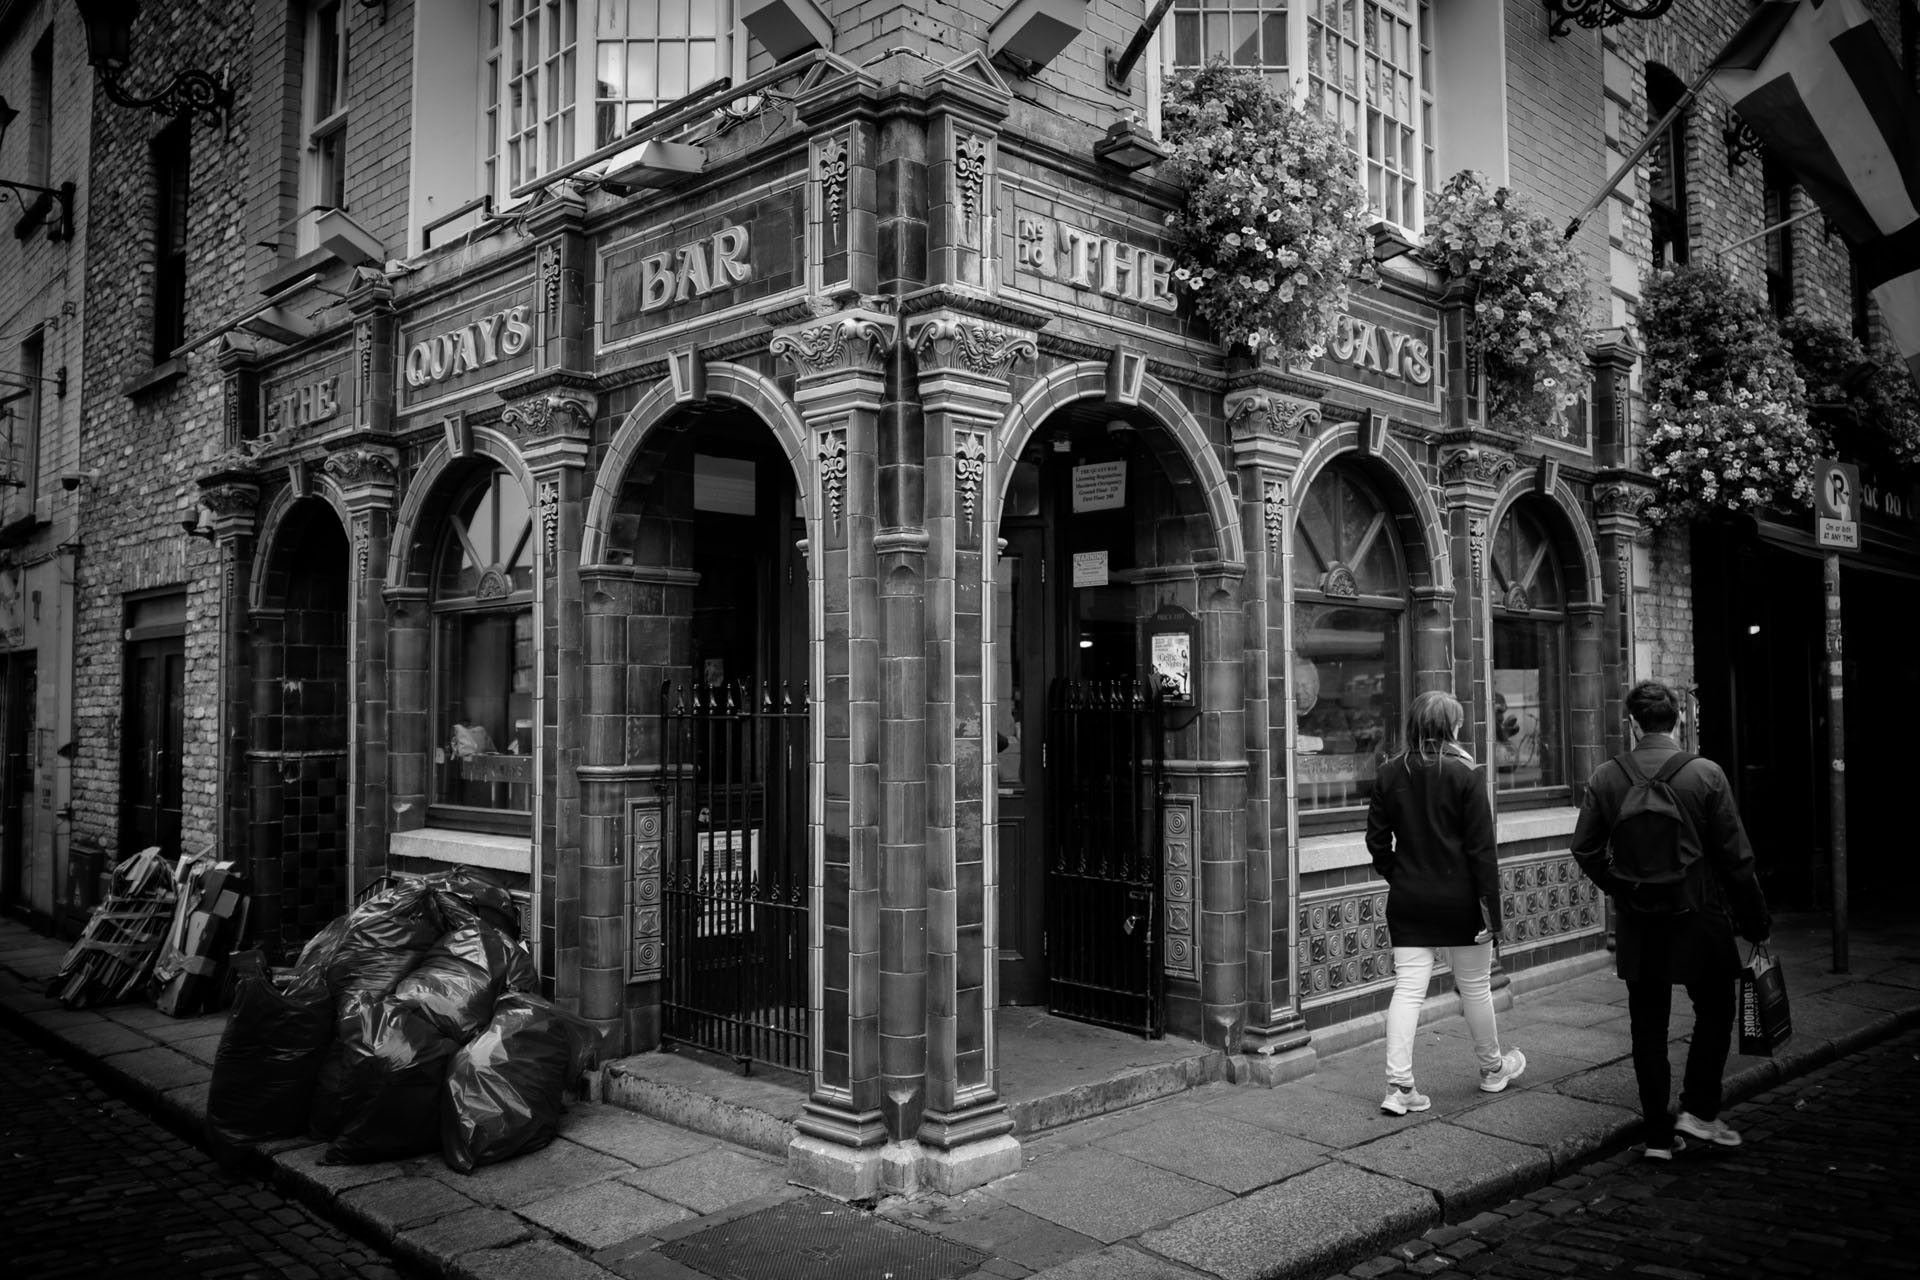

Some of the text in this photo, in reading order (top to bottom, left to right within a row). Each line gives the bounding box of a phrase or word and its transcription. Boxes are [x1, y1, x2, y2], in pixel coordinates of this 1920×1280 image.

[640, 225, 752, 313] BAR
[1019, 244, 1045, 268] 10
[1060, 222, 1178, 315] THE
[405, 304, 532, 387] QUAYS
[1327, 312, 1433, 386] UAYS
[281, 375, 340, 428] THE
[1831, 533, 1841, 541] ANY
[1843, 534, 1854, 543] TIME
[1744, 982, 1755, 1037] STOREHOUSE
